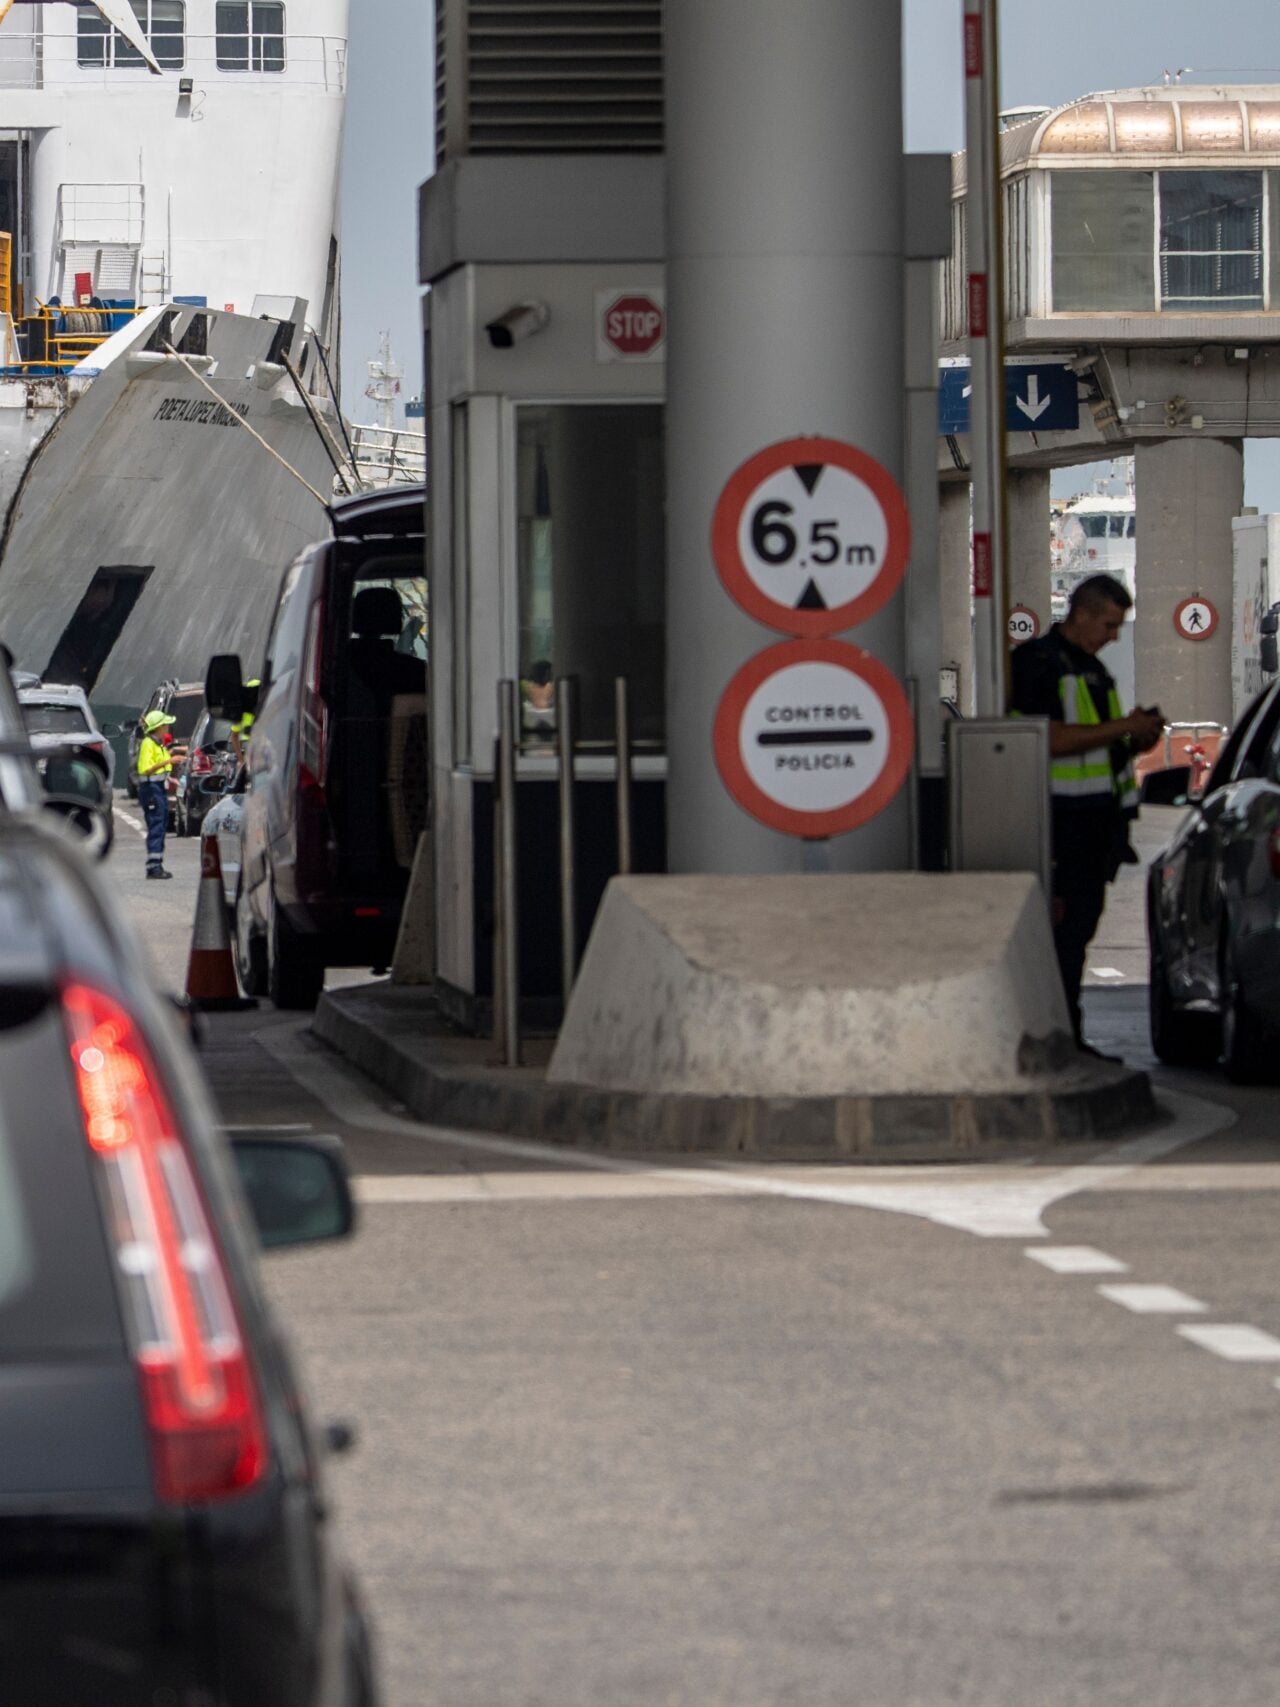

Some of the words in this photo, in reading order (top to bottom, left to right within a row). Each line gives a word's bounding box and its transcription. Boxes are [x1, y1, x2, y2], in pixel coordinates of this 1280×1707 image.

[609, 311, 659, 338] STOP
[153, 398, 191, 421] POETA
[1009, 620, 1033, 632] 30t
[765, 704, 863, 723] CONTROL
[775, 752, 855, 771] POLICIA
